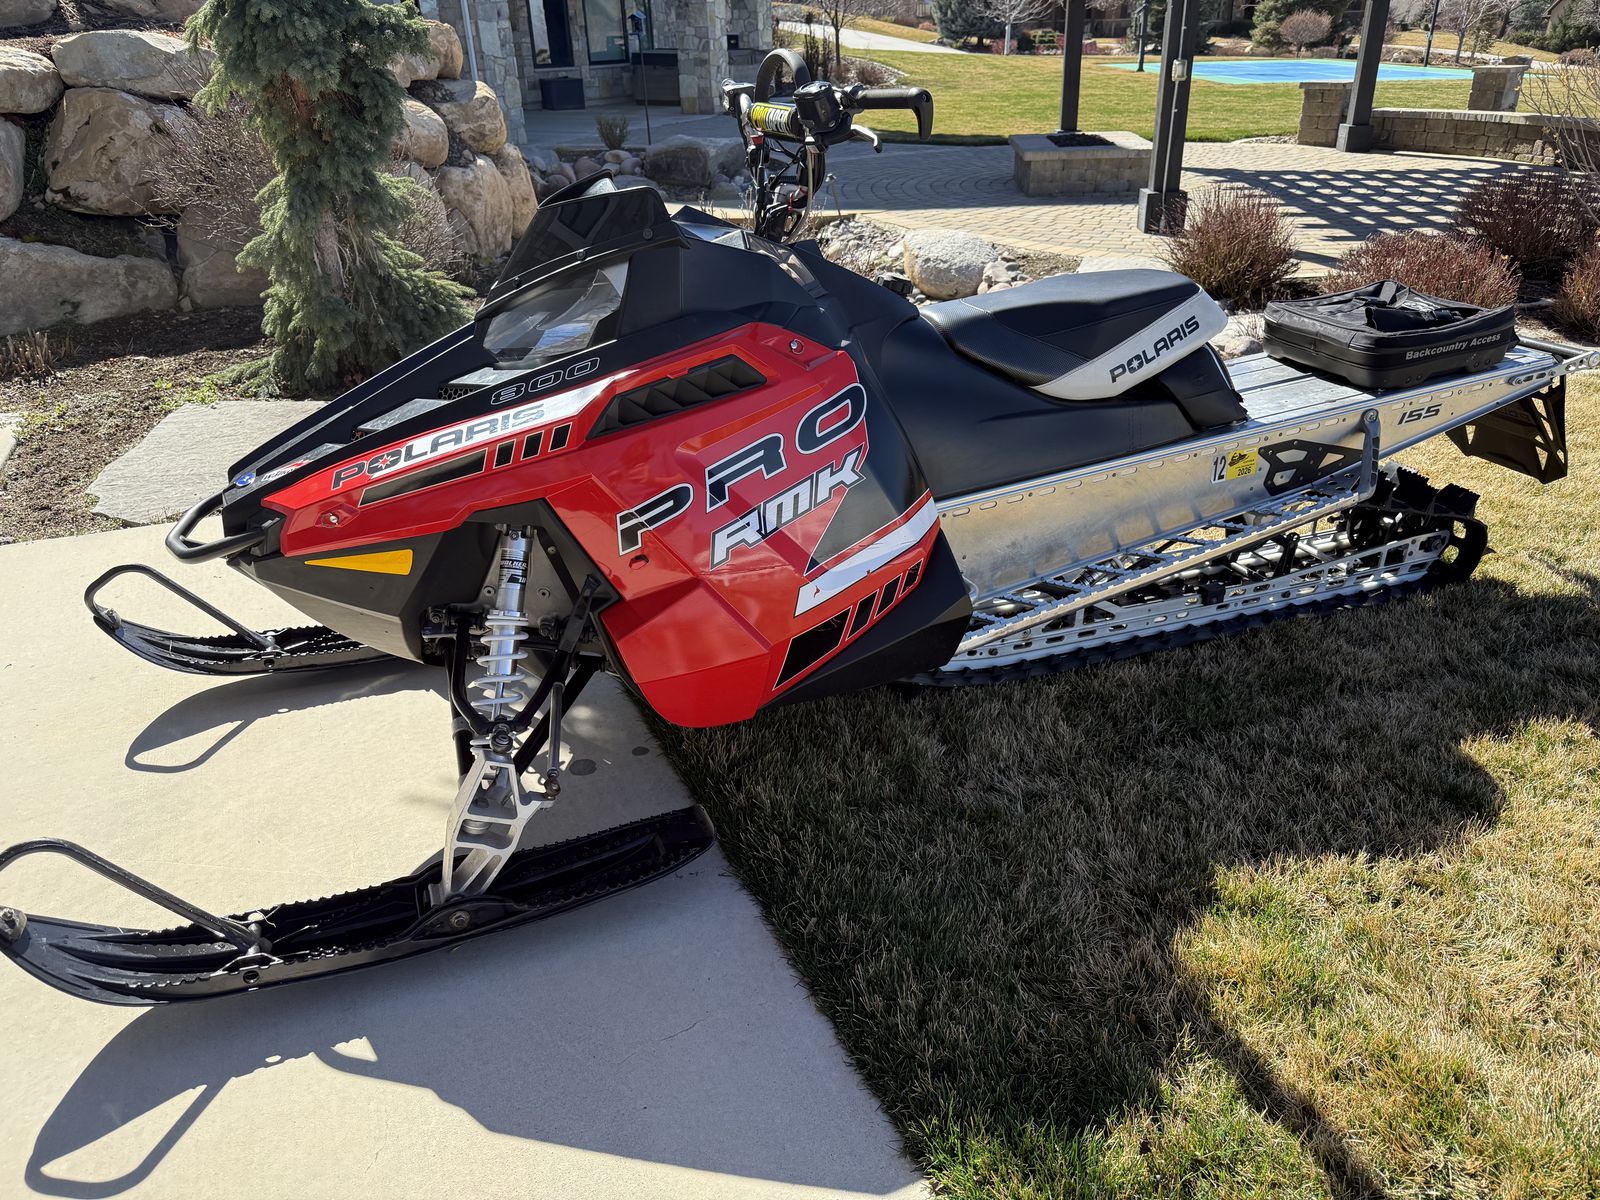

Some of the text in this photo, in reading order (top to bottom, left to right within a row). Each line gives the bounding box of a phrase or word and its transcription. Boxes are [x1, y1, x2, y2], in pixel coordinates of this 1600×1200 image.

[1109, 315, 1200, 384] POLARIS
[1405, 333, 1501, 360] Backcountry Access
[491, 357, 600, 405] 800
[1397, 403, 1442, 425] 155
[331, 403, 545, 490] POLARIS
[616, 383, 868, 556] PRO
[1213, 456, 1226, 481] 12
[710, 442, 866, 571] RMK
